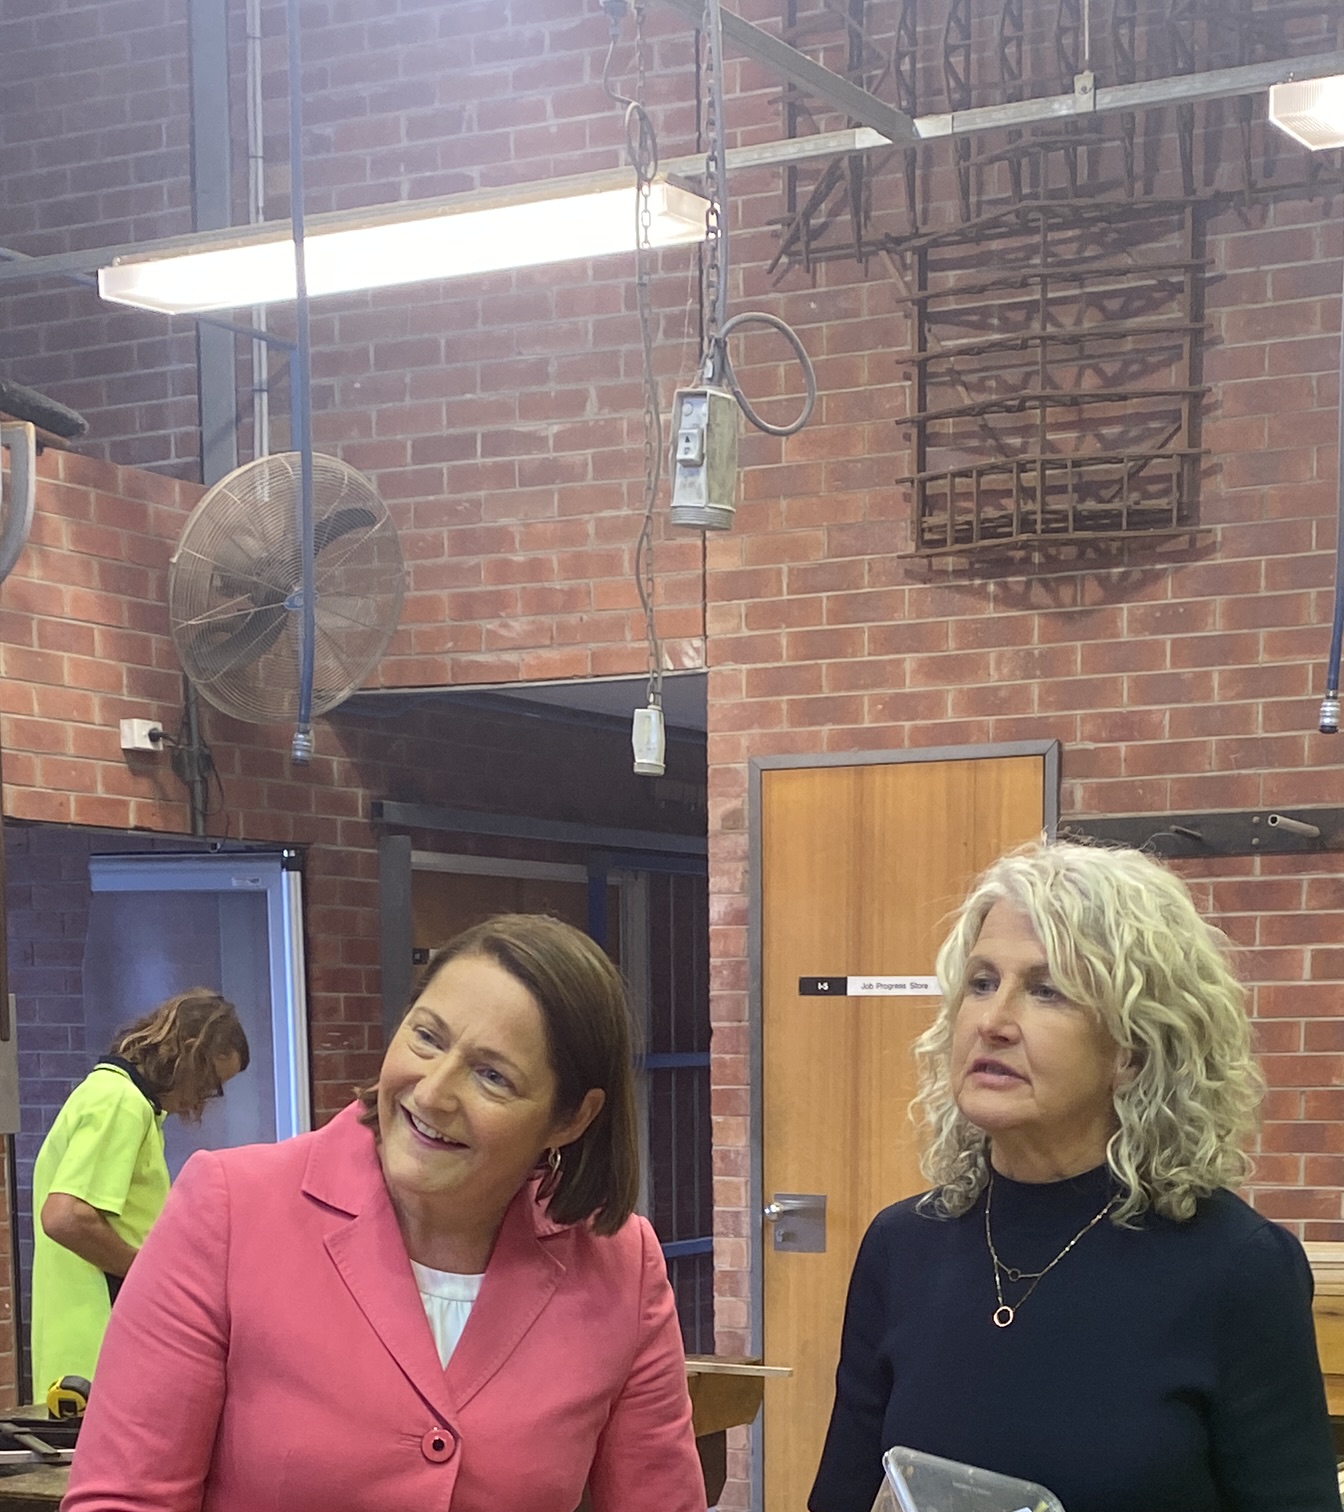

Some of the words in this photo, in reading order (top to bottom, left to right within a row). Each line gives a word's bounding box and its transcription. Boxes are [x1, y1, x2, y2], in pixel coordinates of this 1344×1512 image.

[860, 982, 874, 990] Job
[876, 982, 906, 991] Progress
[910, 982, 928, 990] Store
